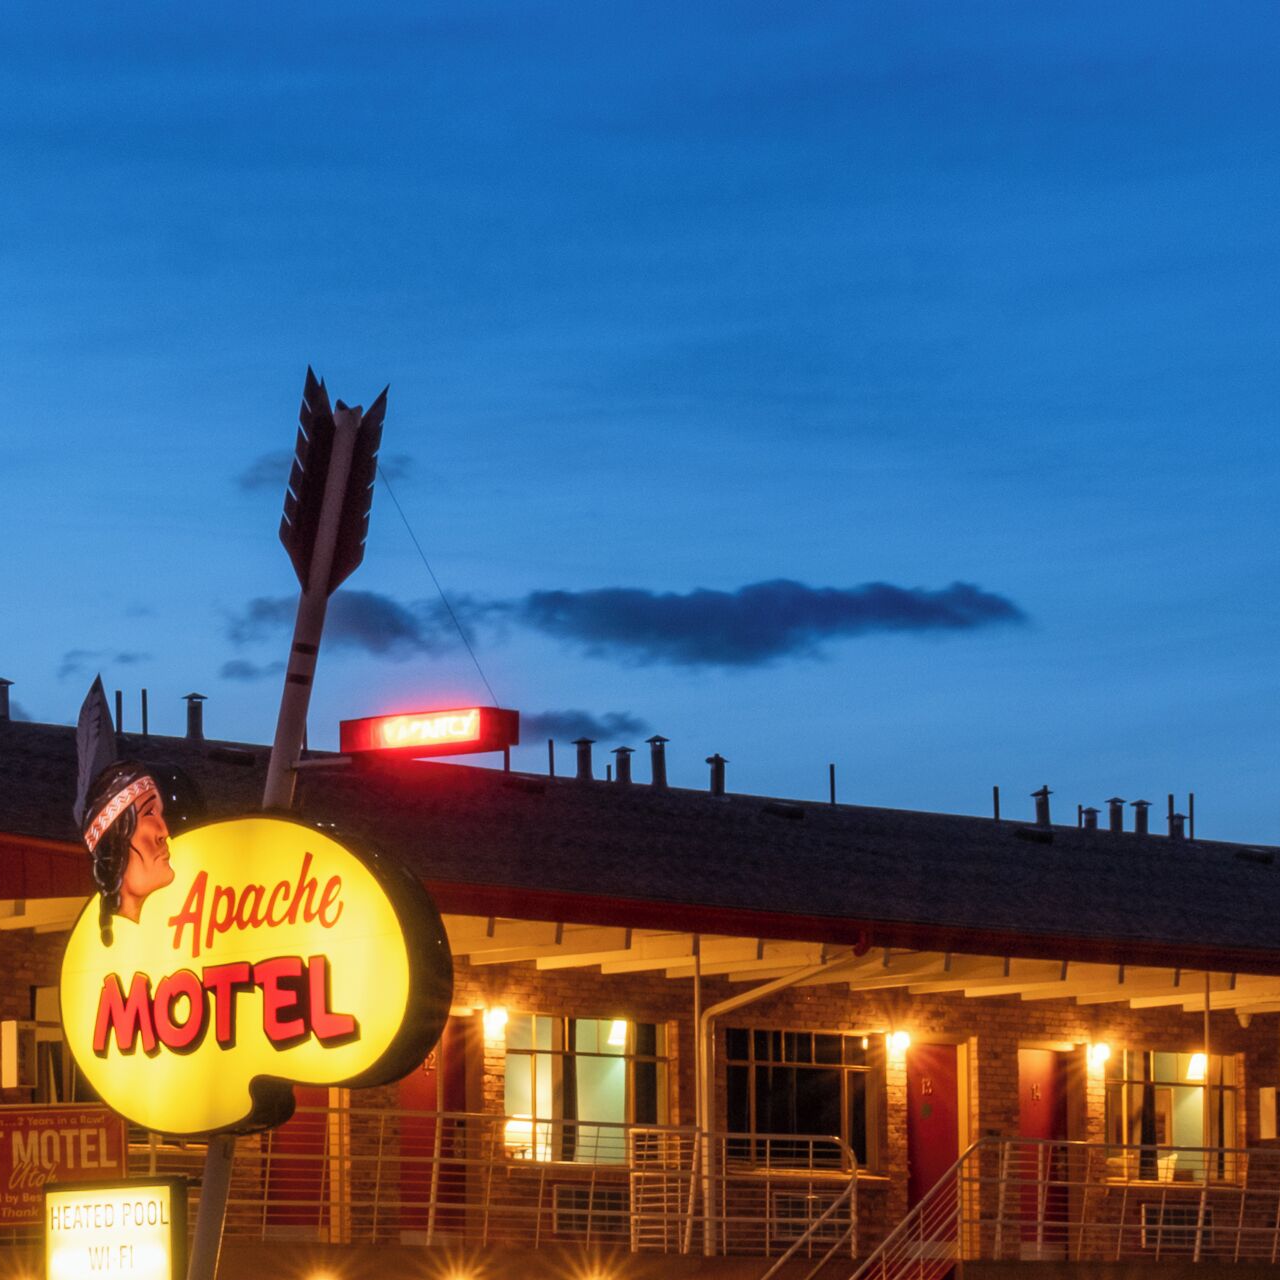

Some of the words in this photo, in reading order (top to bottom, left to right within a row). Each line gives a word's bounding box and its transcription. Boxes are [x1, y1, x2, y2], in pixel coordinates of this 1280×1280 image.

[168, 852, 344, 958] Apache
[93, 954, 360, 1059] MOTEL
[27, 1116, 54, 1126] Years
[56, 1117, 68, 1125] in
[12, 1127, 117, 1170] MOTEL
[9, 1162, 58, 1190] Utah
[1, 1205, 39, 1217] Thank
[5, 1193, 19, 1205] by
[22, 1192, 43, 1203] Bes
[50, 1203, 114, 1231] HEATED
[122, 1200, 169, 1227] POOL
